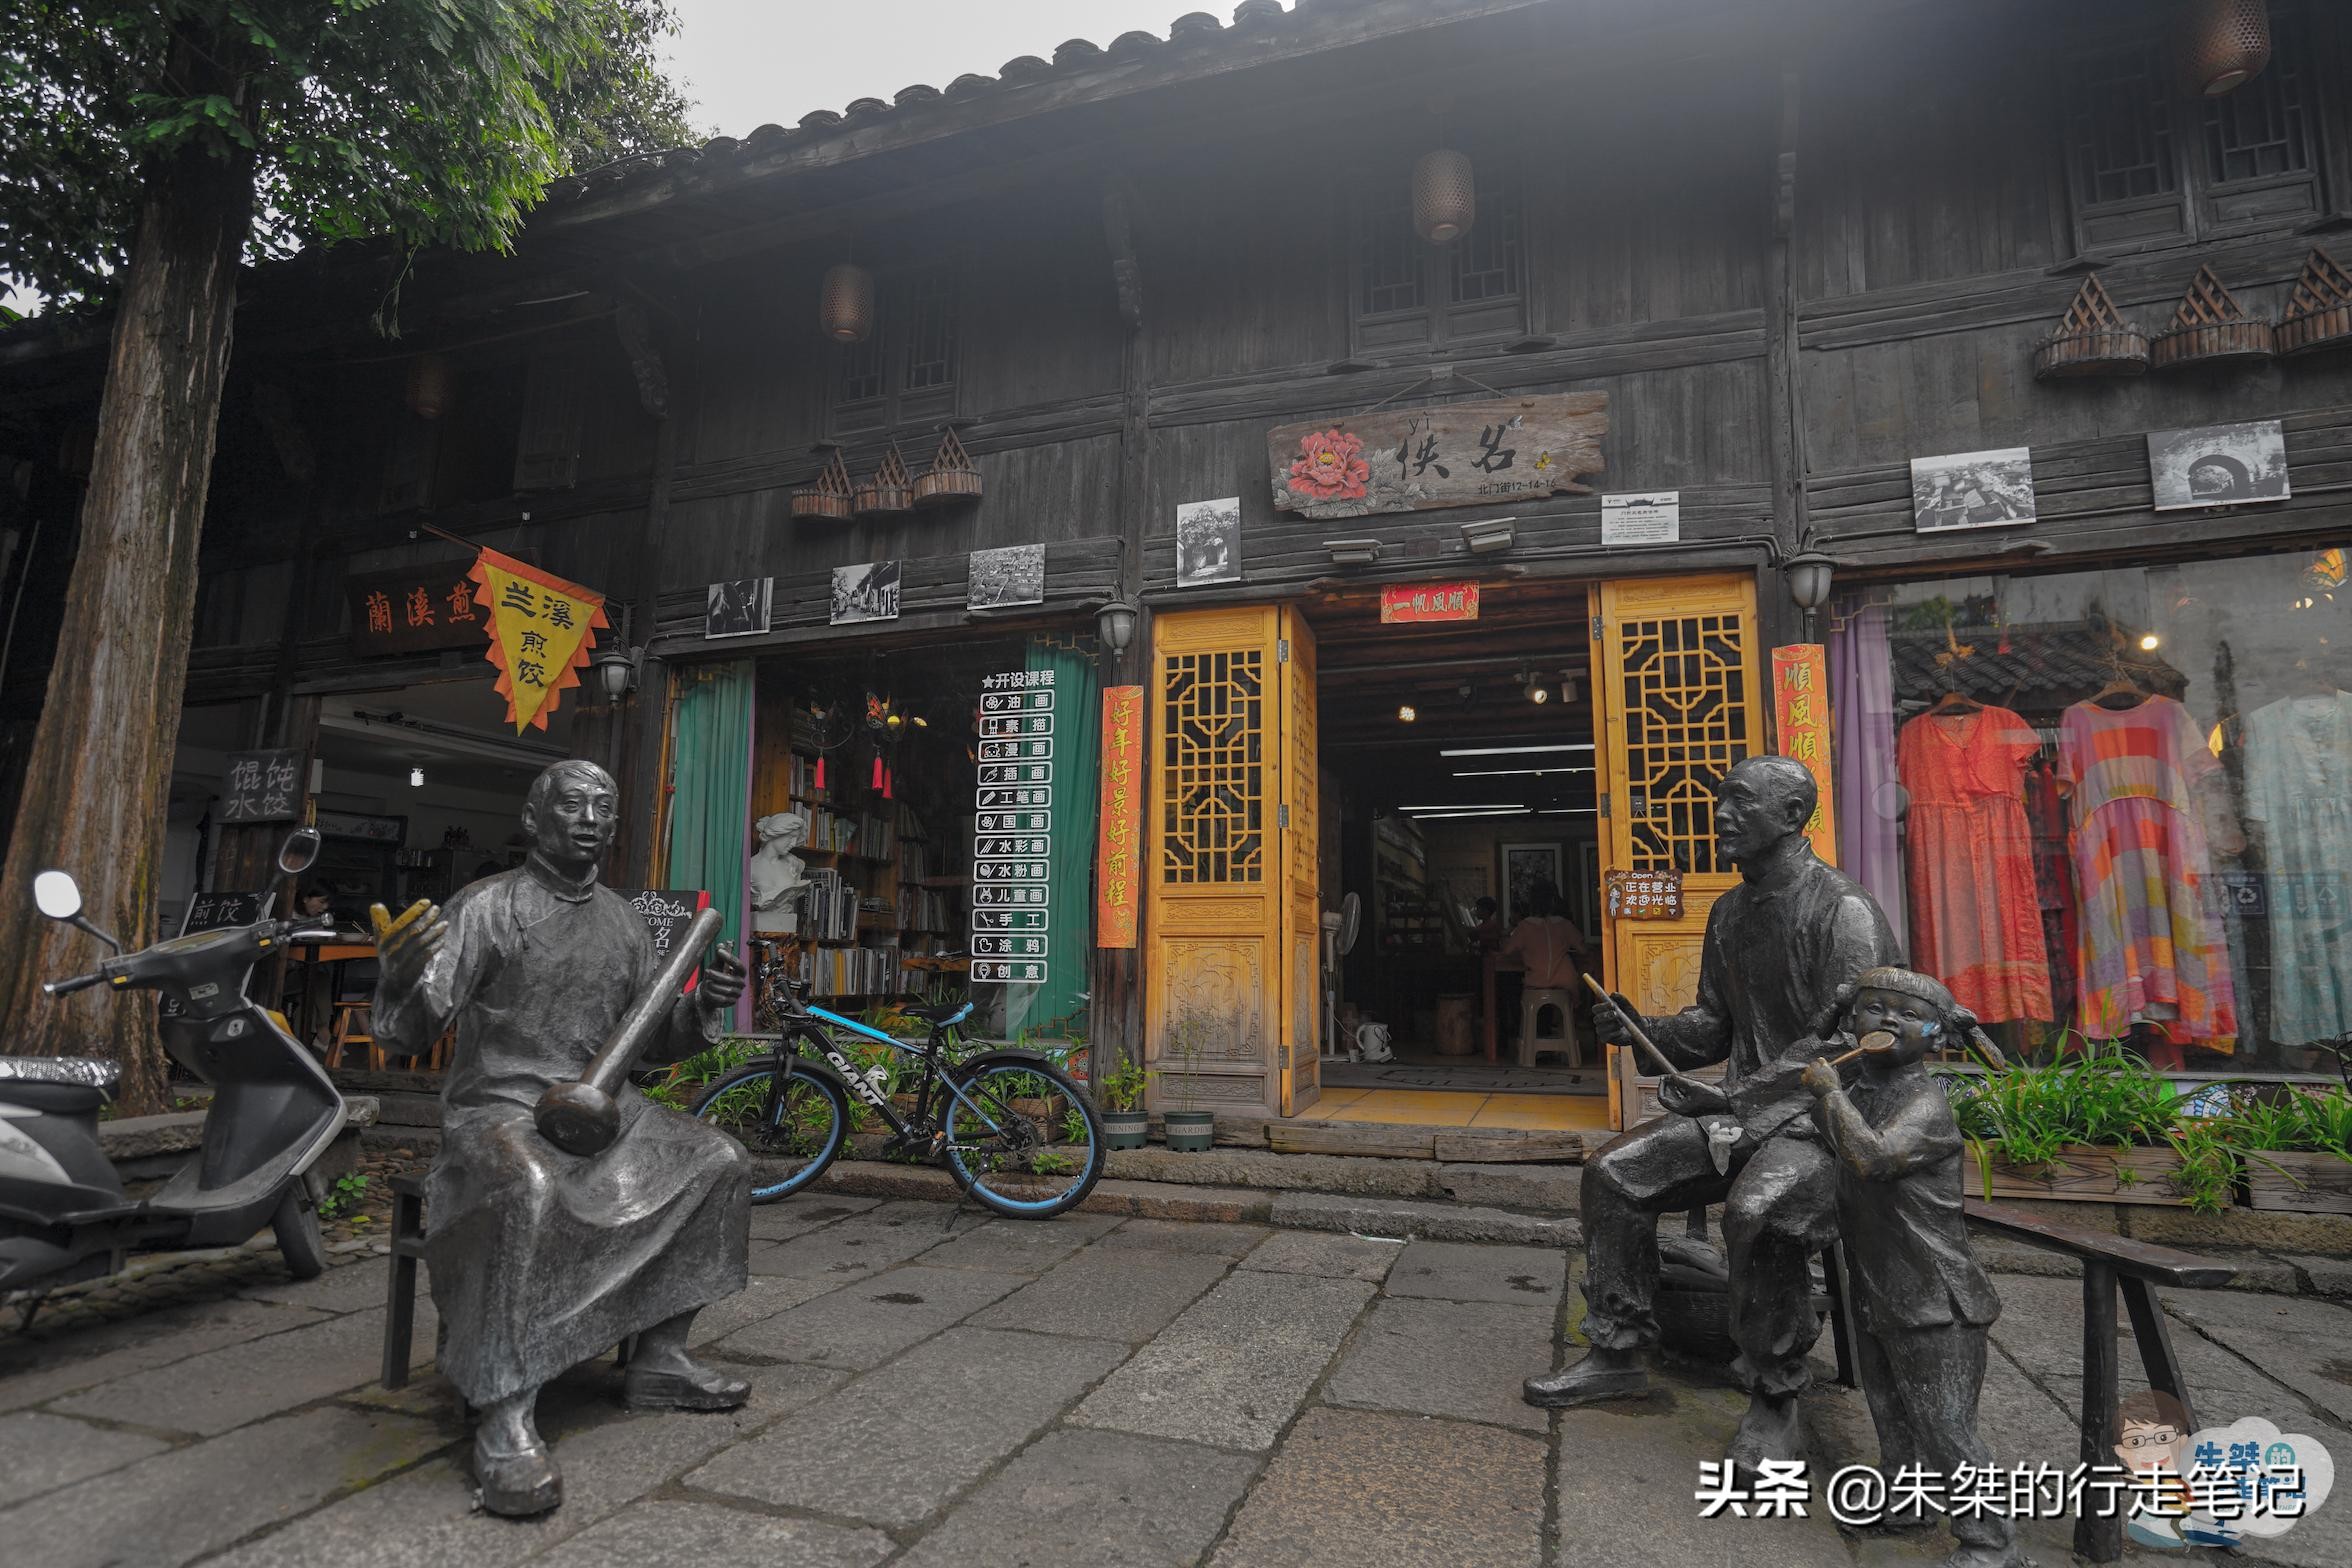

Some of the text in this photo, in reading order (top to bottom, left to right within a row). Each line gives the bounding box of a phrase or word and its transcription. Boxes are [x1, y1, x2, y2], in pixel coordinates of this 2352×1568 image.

[501, 580, 575, 630] 兰溪
[517, 630, 548, 688] 煎饺
[995, 670, 1055, 688] 开设课程
[1007, 694, 1049, 710] 油画
[1005, 718, 1047, 733] 素描
[1004, 742, 1046, 757] 漫画
[231, 757, 295, 792] 馄饨
[1003, 766, 1045, 781] 插画
[1000, 790, 1046, 804] 工笔画
[1103, 701, 1135, 907] 好年好景好前程
[225, 794, 294, 820] 水饺
[1002, 815, 1045, 829] 国画
[998, 839, 1045, 854] 水彩画
[998, 864, 1044, 878] 水粉画
[1631, 872, 1654, 880] Open
[1625, 881, 1677, 894] 正在营业
[997, 889, 1043, 903] 儿童画
[1625, 894, 1678, 906] 欢迎光临
[189, 899, 243, 926] 煎饺
[998, 913, 1040, 927] 手工
[998, 939, 1040, 953] 涂鸦
[997, 964, 1039, 979] 创意
[826, 1051, 884, 1106] GIANT
